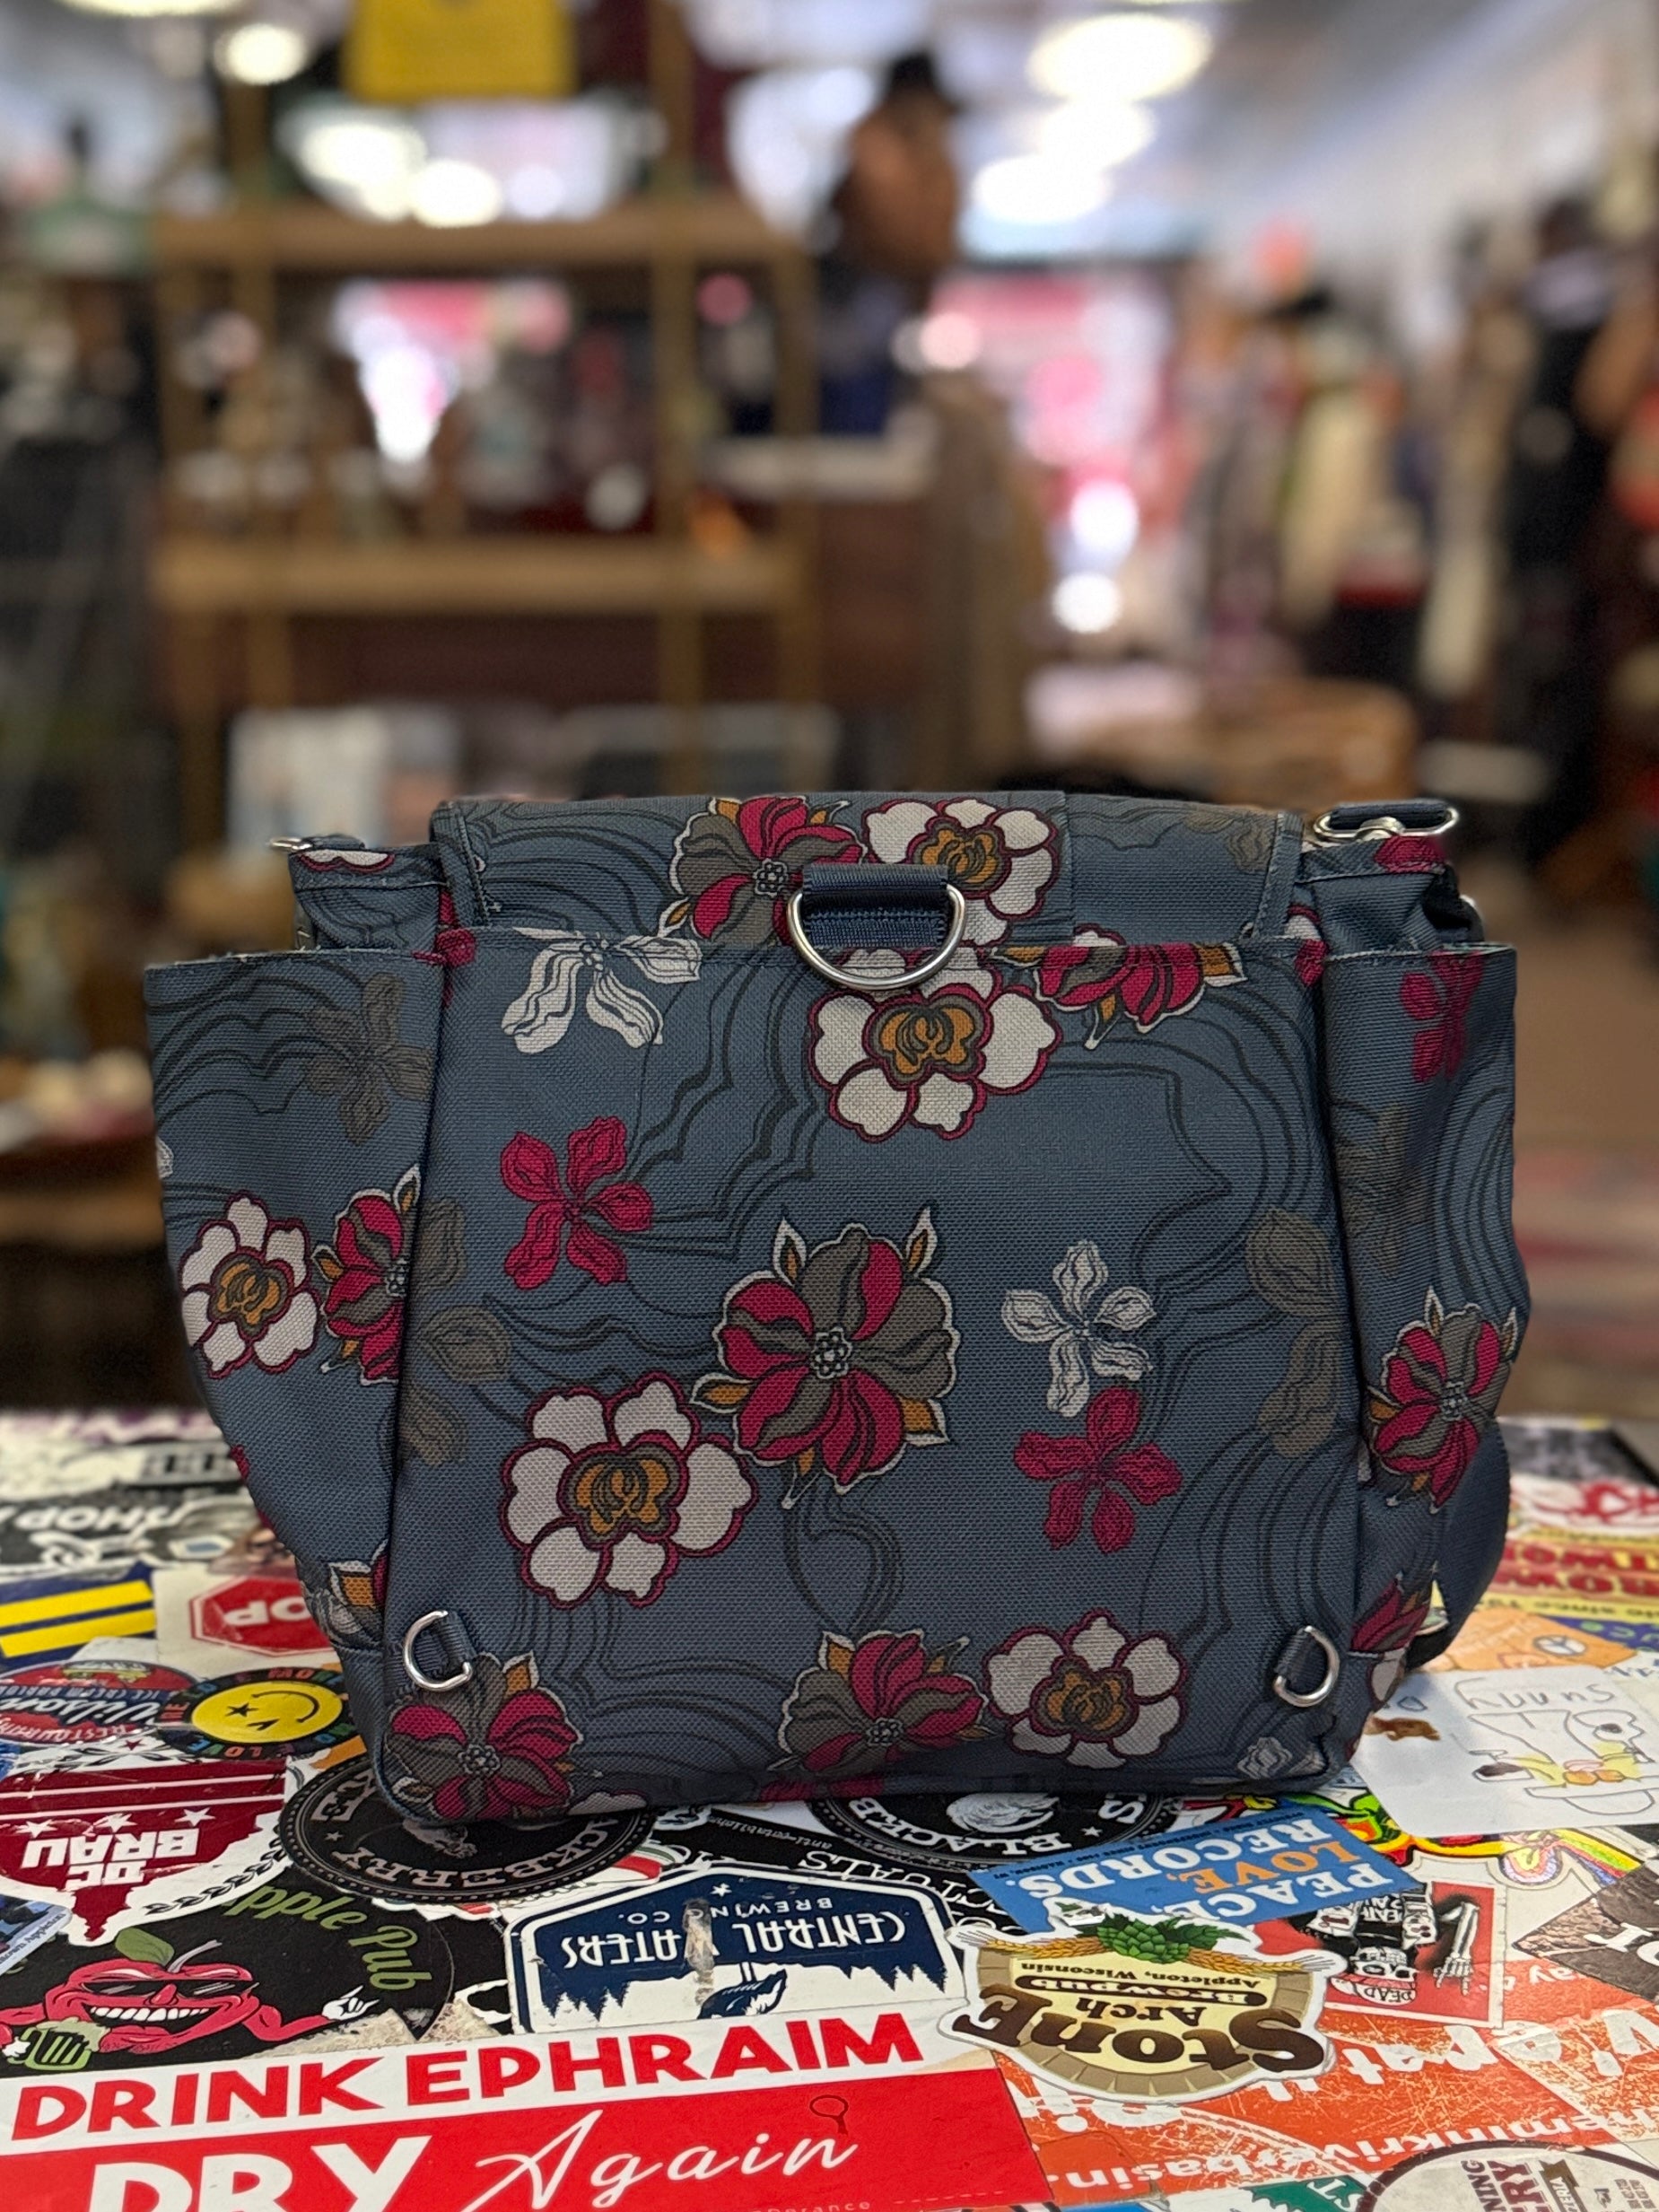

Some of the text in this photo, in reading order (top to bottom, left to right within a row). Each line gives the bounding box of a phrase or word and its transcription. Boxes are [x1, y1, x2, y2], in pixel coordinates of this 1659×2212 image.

[223, 1596, 310, 1627] OP
[135, 1690, 160, 1700] ICE
[849, 1796, 1071, 1855] BLACKB
[19, 1828, 199, 1869] BRAU
[331, 1818, 617, 1888] CKBERRY
[1006, 1818, 1332, 1899] RECORDS.
[1166, 1840, 1359, 1893] LOVE,
[65, 1860, 146, 1892] DC
[1150, 1862, 1395, 1921] PEACE,
[222, 1885, 432, 1990] pple Pub
[618, 1910, 670, 1925] CO.
[732, 1911, 905, 1953] CENTRAL
[1021, 1963, 1260, 1989] Appleton, Wisconsin
[1028, 1978, 1248, 2005] Brewpub
[1364, 1986, 1413, 2004] DEAD
[1075, 1997, 1207, 2026] Arch
[12, 2012, 924, 2141] DRINK EPHRAIM
[89, 2135, 432, 2212] DRY
[459, 2109, 859, 2212] Again
